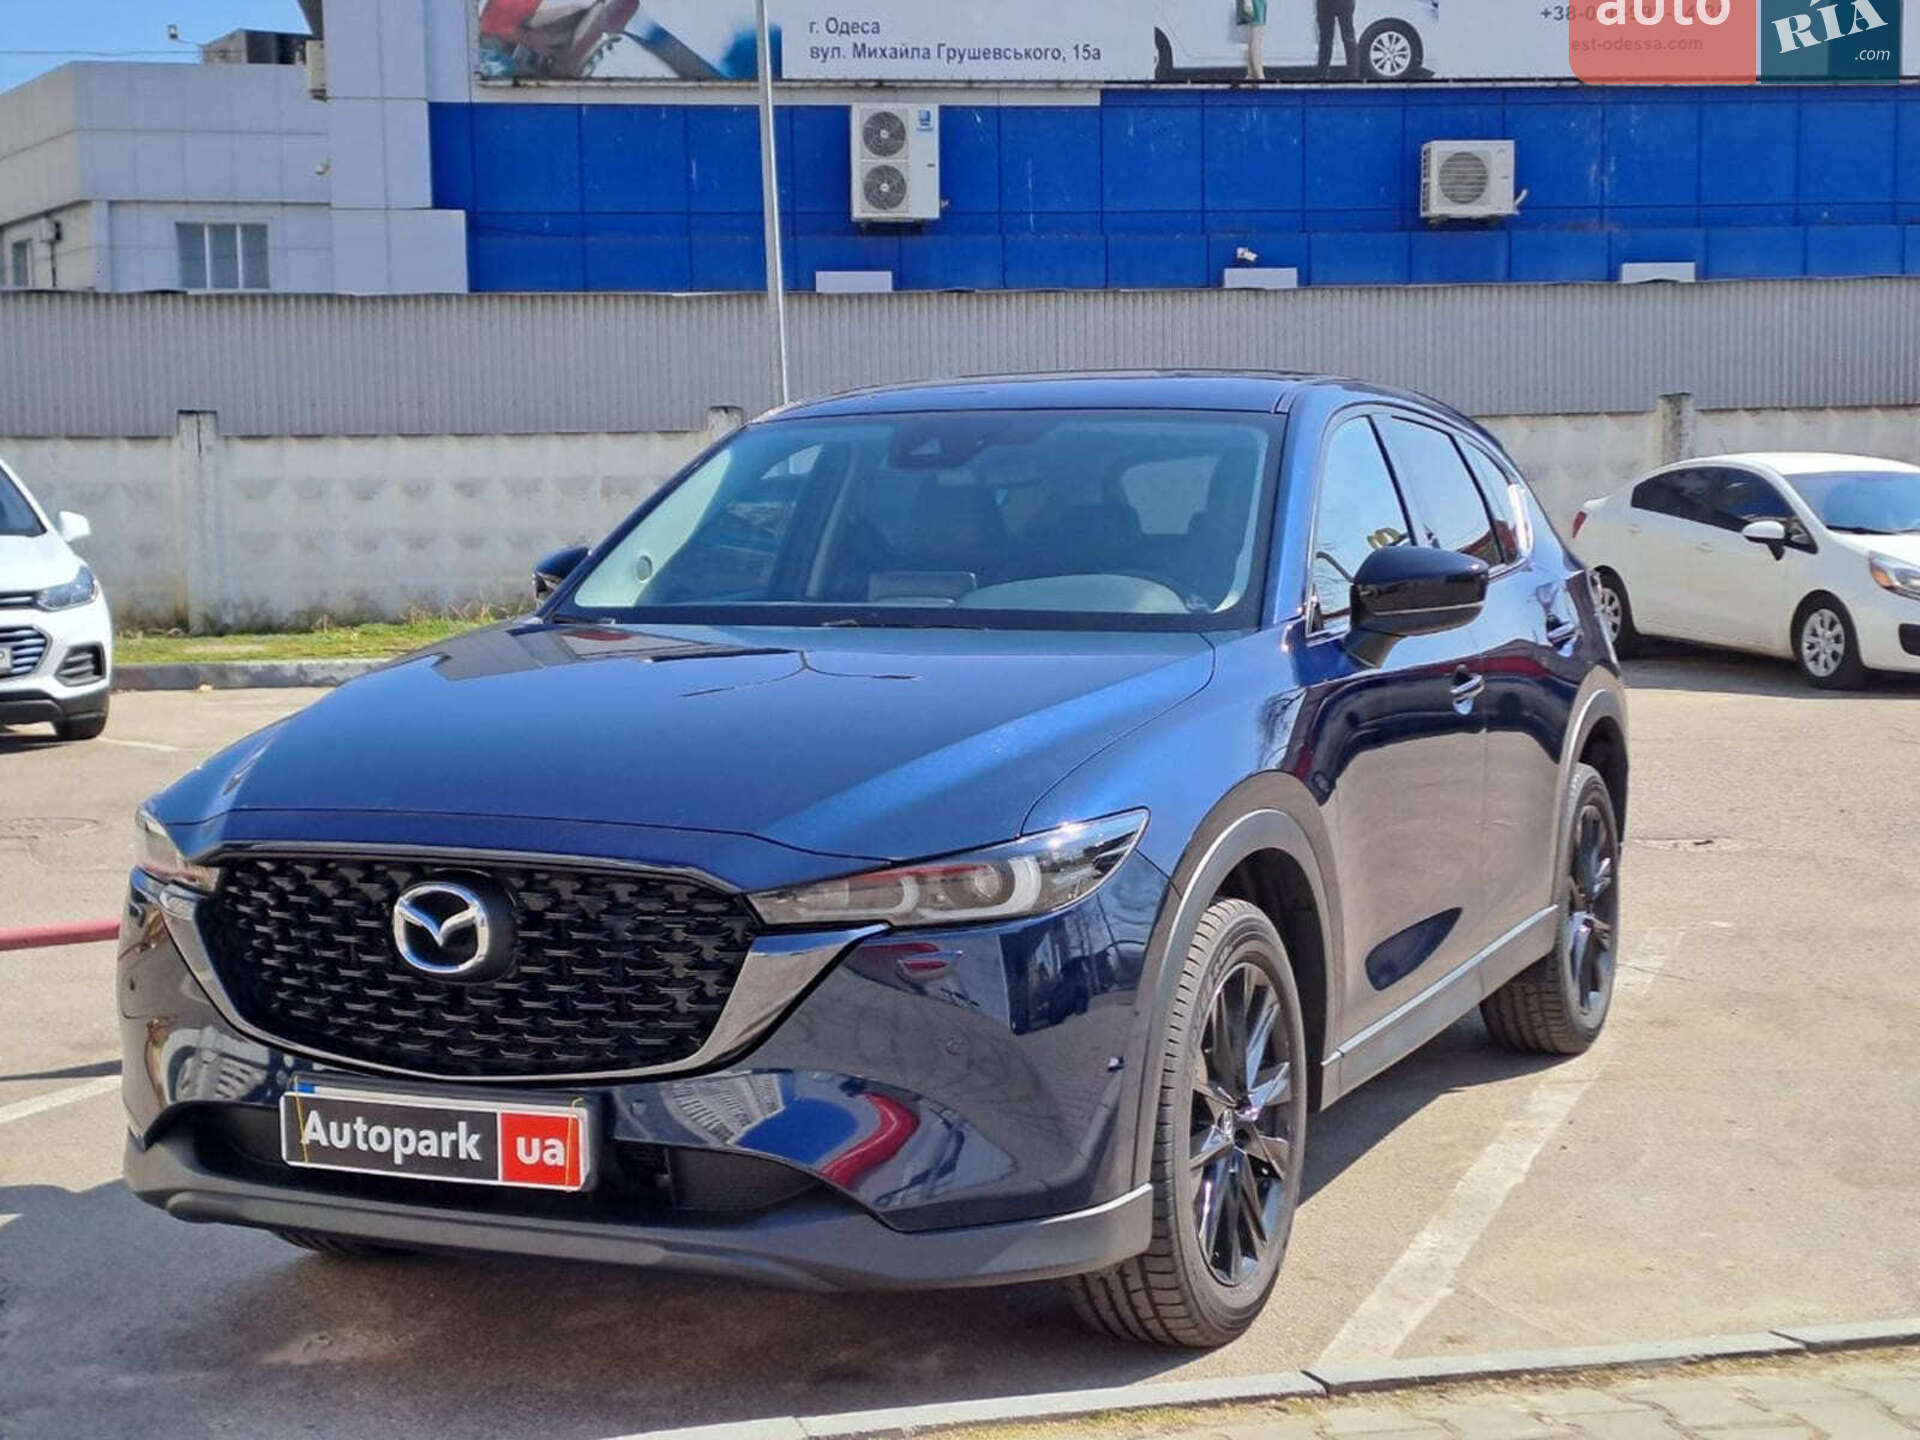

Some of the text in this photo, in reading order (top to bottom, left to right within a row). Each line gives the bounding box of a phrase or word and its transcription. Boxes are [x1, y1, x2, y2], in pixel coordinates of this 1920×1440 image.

[808, 17, 880, 36] г. Одеса
[810, 42, 1101, 64] вул. Михайла Грушевського, 15а
[301, 1110, 566, 1167] Autopark ua
